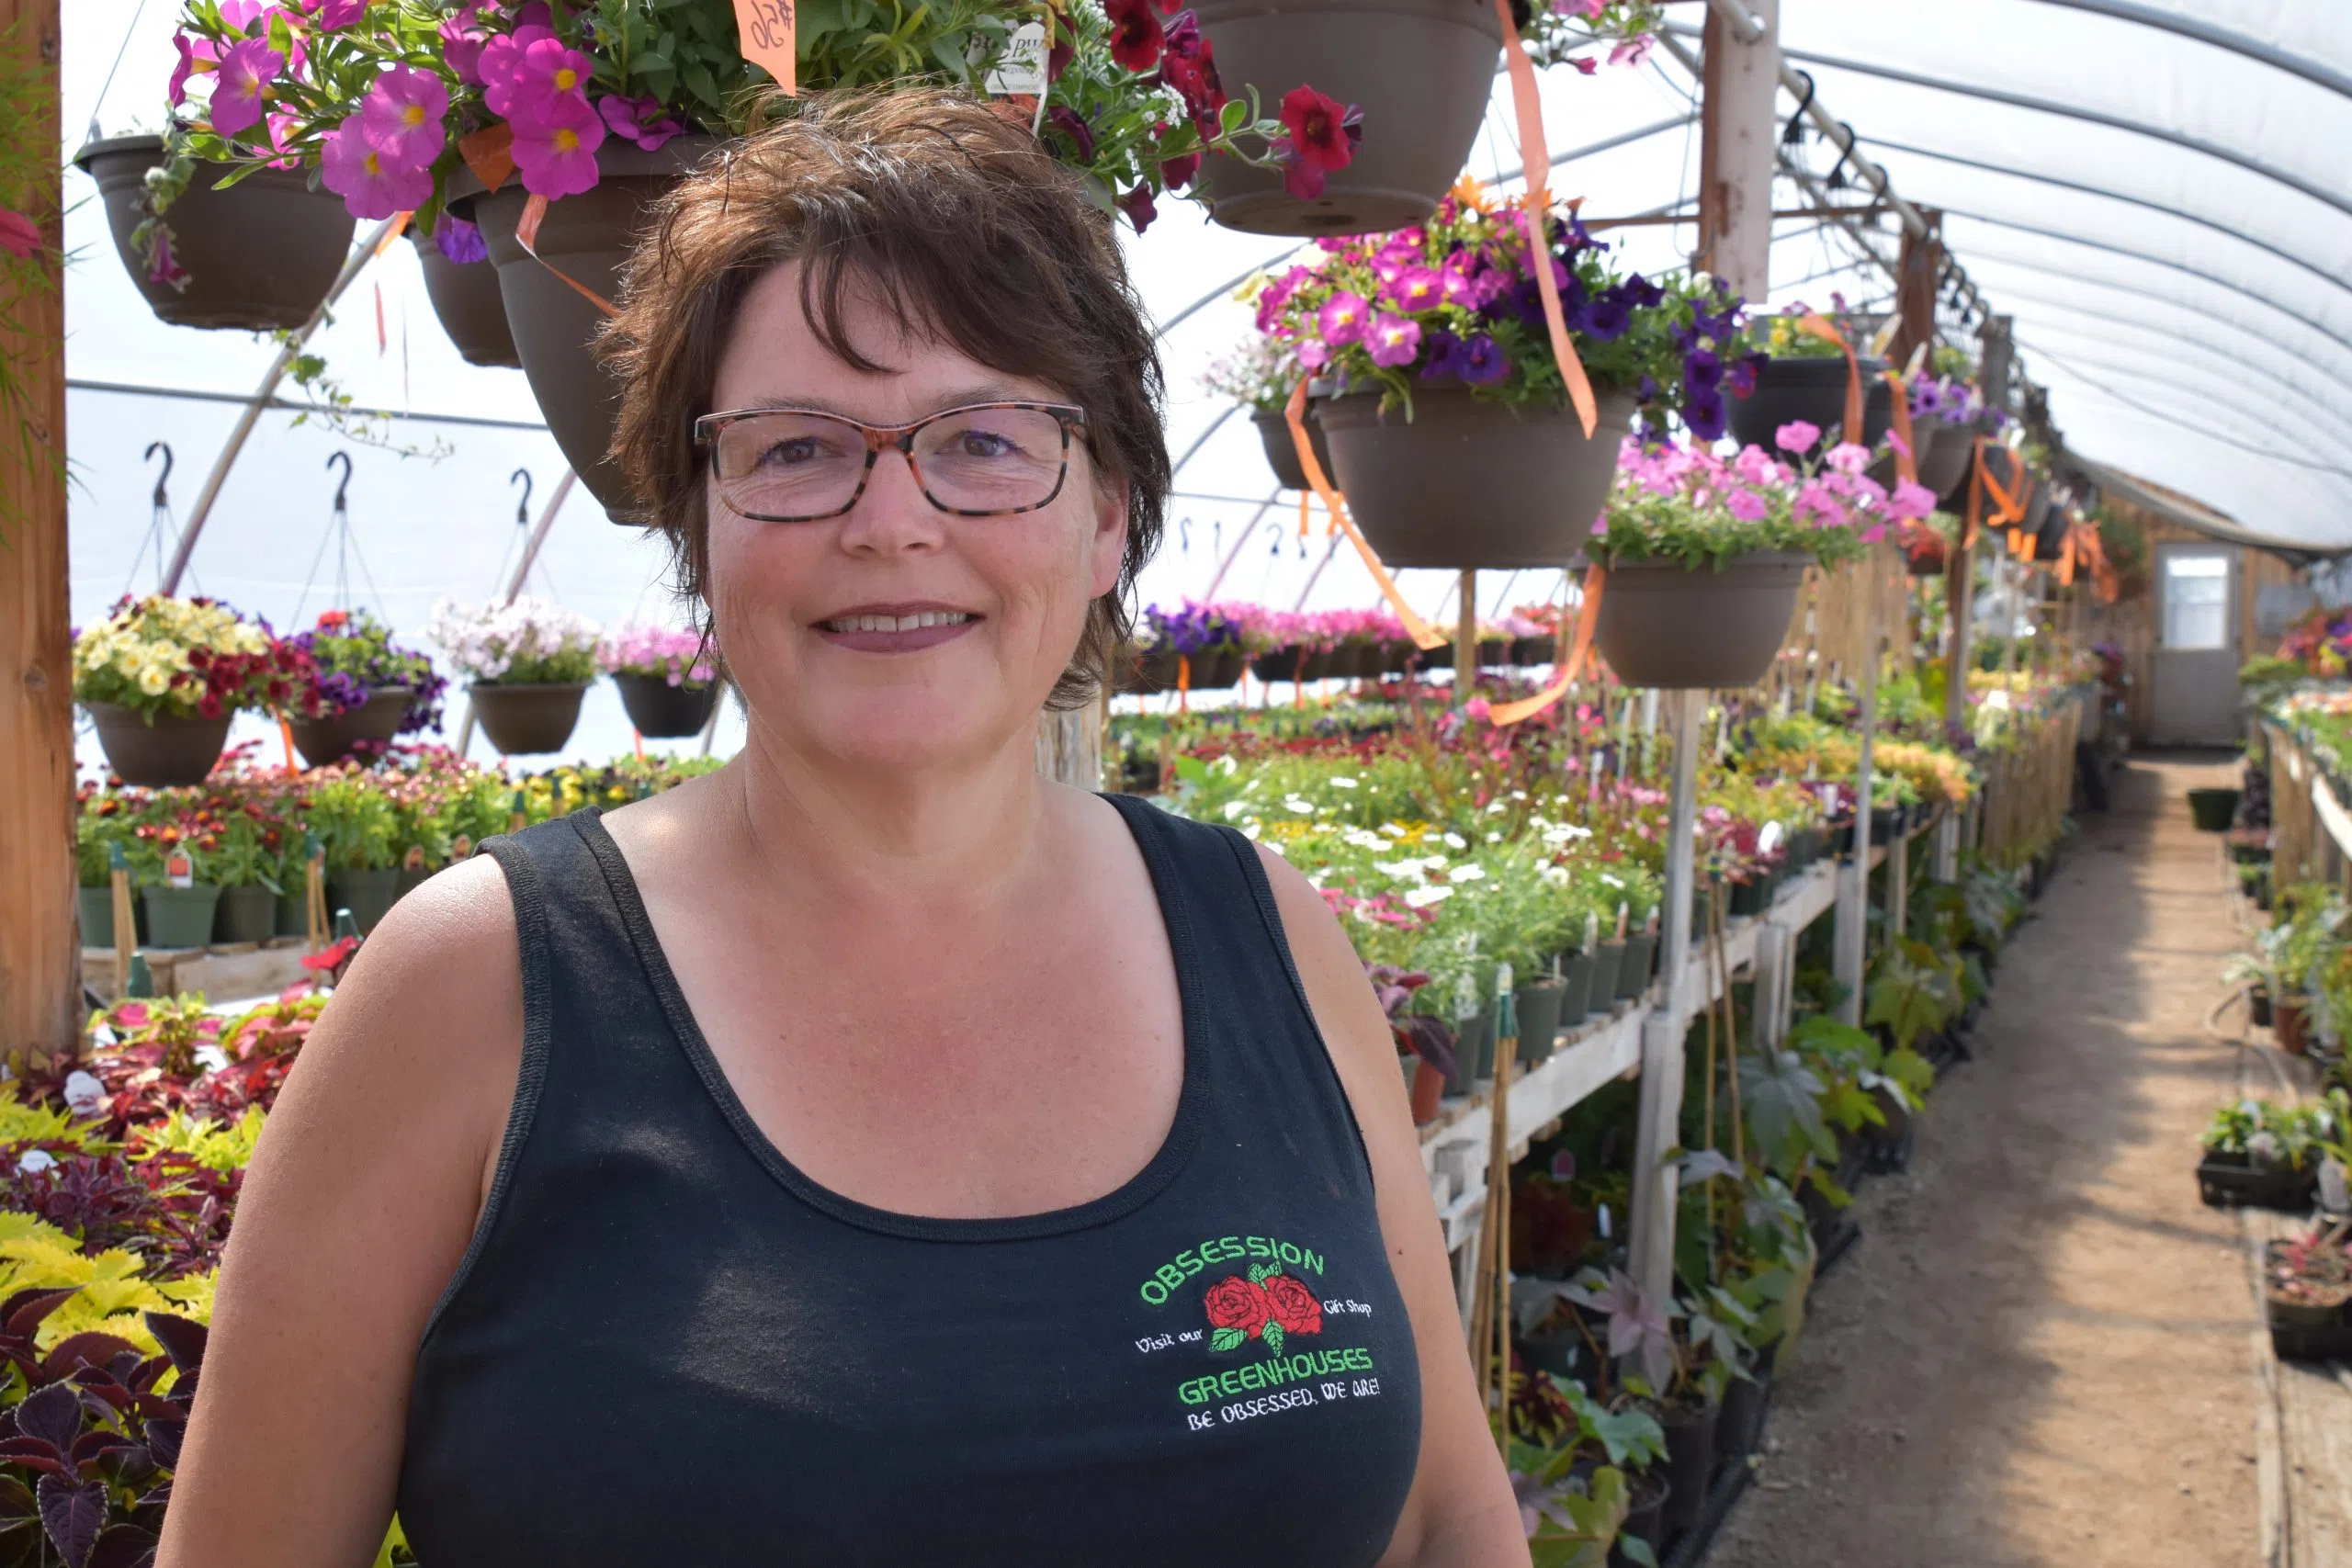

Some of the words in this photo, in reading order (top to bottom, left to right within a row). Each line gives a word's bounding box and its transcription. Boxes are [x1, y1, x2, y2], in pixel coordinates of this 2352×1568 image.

[1140, 1235, 1324, 1304] OBSESSION
[1136, 1334, 1174, 1353] Visit
[1179, 1329, 1203, 1342] our
[1324, 1299, 1345, 1314] Gift
[1346, 1299, 1372, 1317] Shop
[1178, 1348, 1374, 1404] GREENHOUSES
[1188, 1410, 1216, 1430] BE
[1221, 1388, 1319, 1423] OBSESSED,
[1321, 1382, 1347, 1401] WE
[1352, 1378, 1381, 1397] ARE!
